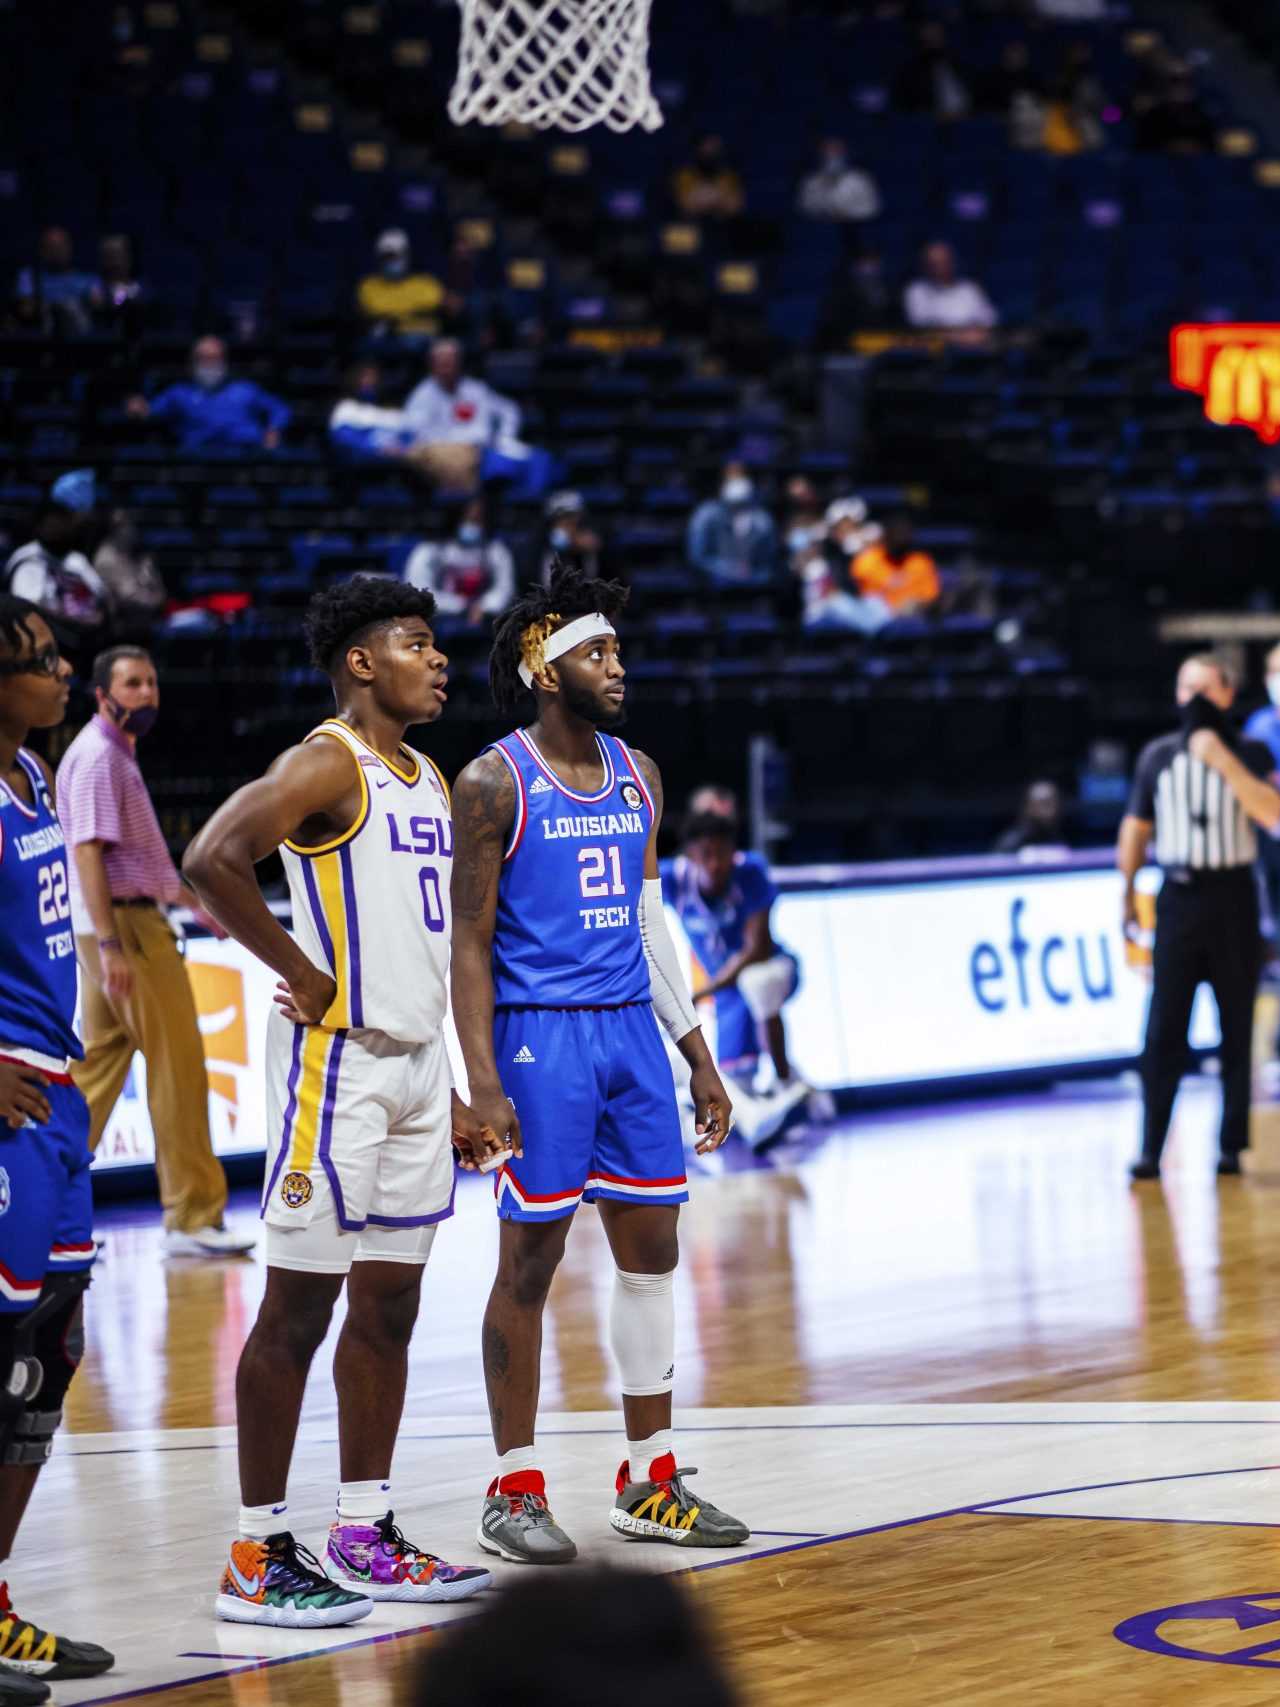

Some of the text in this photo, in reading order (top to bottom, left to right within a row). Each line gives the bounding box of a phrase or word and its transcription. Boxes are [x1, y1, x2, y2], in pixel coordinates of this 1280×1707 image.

[386, 813, 454, 858] LSU
[542, 813, 644, 840] LOUISIANA
[38, 860, 71, 926] 22
[577, 846, 626, 897] 21
[418, 866, 445, 933] 0
[579, 906, 630, 930] TECH
[970, 897, 1114, 1014] efcu
